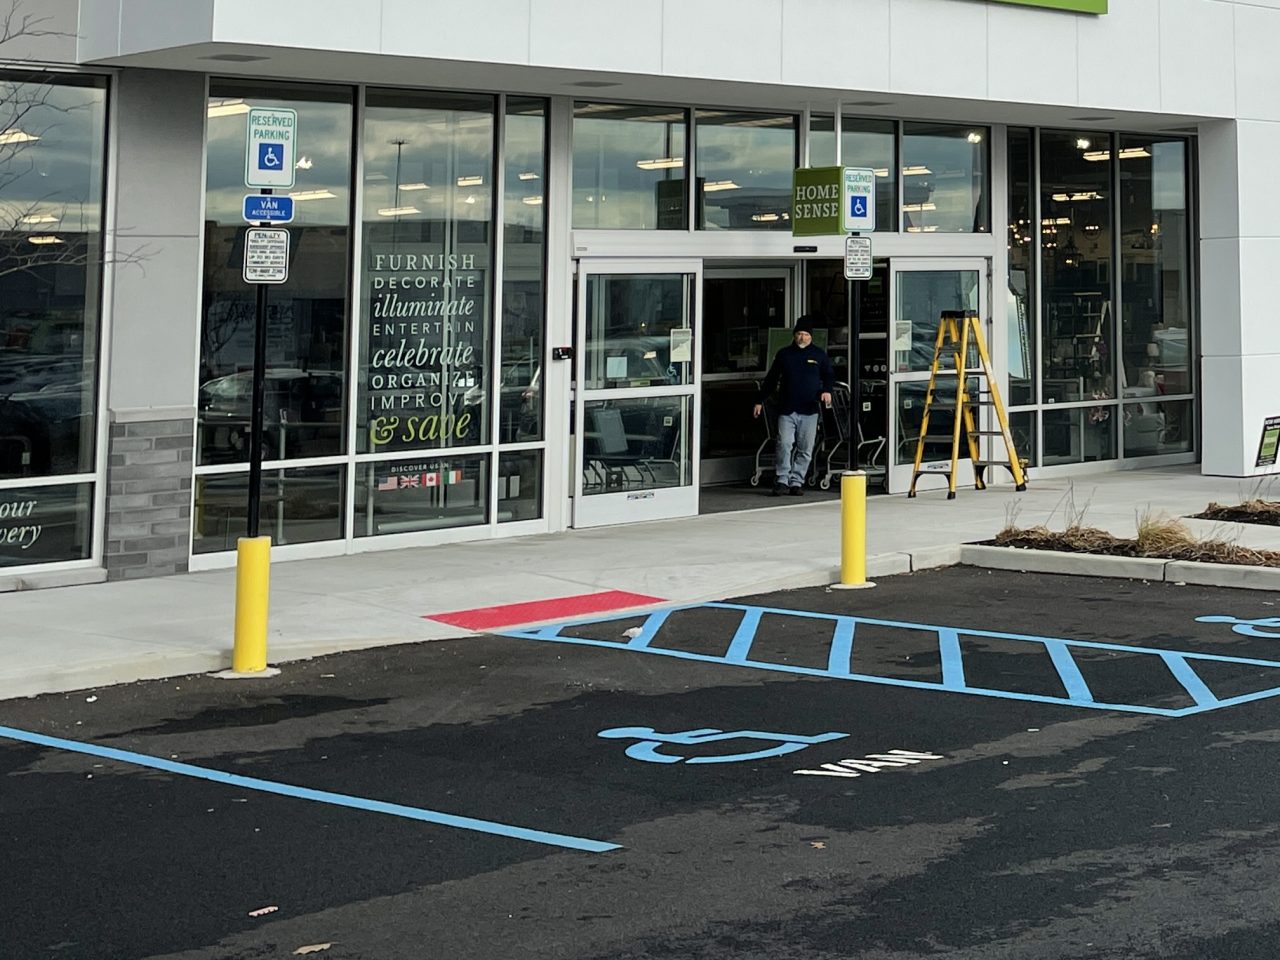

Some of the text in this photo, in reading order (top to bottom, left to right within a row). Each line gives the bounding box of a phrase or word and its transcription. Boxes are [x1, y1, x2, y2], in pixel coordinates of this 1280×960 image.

[251, 115, 293, 128] RESERVED
[253, 128, 290, 141] PARKING
[796, 184, 839, 200] HOME
[847, 184, 871, 194] PARKING
[260, 200, 278, 209] VAN
[795, 202, 839, 219] SENSE
[251, 209, 286, 217] ACCESSIBLE
[375, 254, 475, 271] FURNISH
[374, 275, 475, 289] DECORATE
[373, 292, 475, 318] illuminate
[373, 321, 474, 336] ENTERTAIN
[372, 338, 474, 368] celebrate
[371, 370, 474, 389] ORGANIZE
[369, 412, 472, 445] & save
[391, 464, 427, 473] DISCOVER
[0, 500, 38, 518] our
[792, 749, 945, 778] VAN
